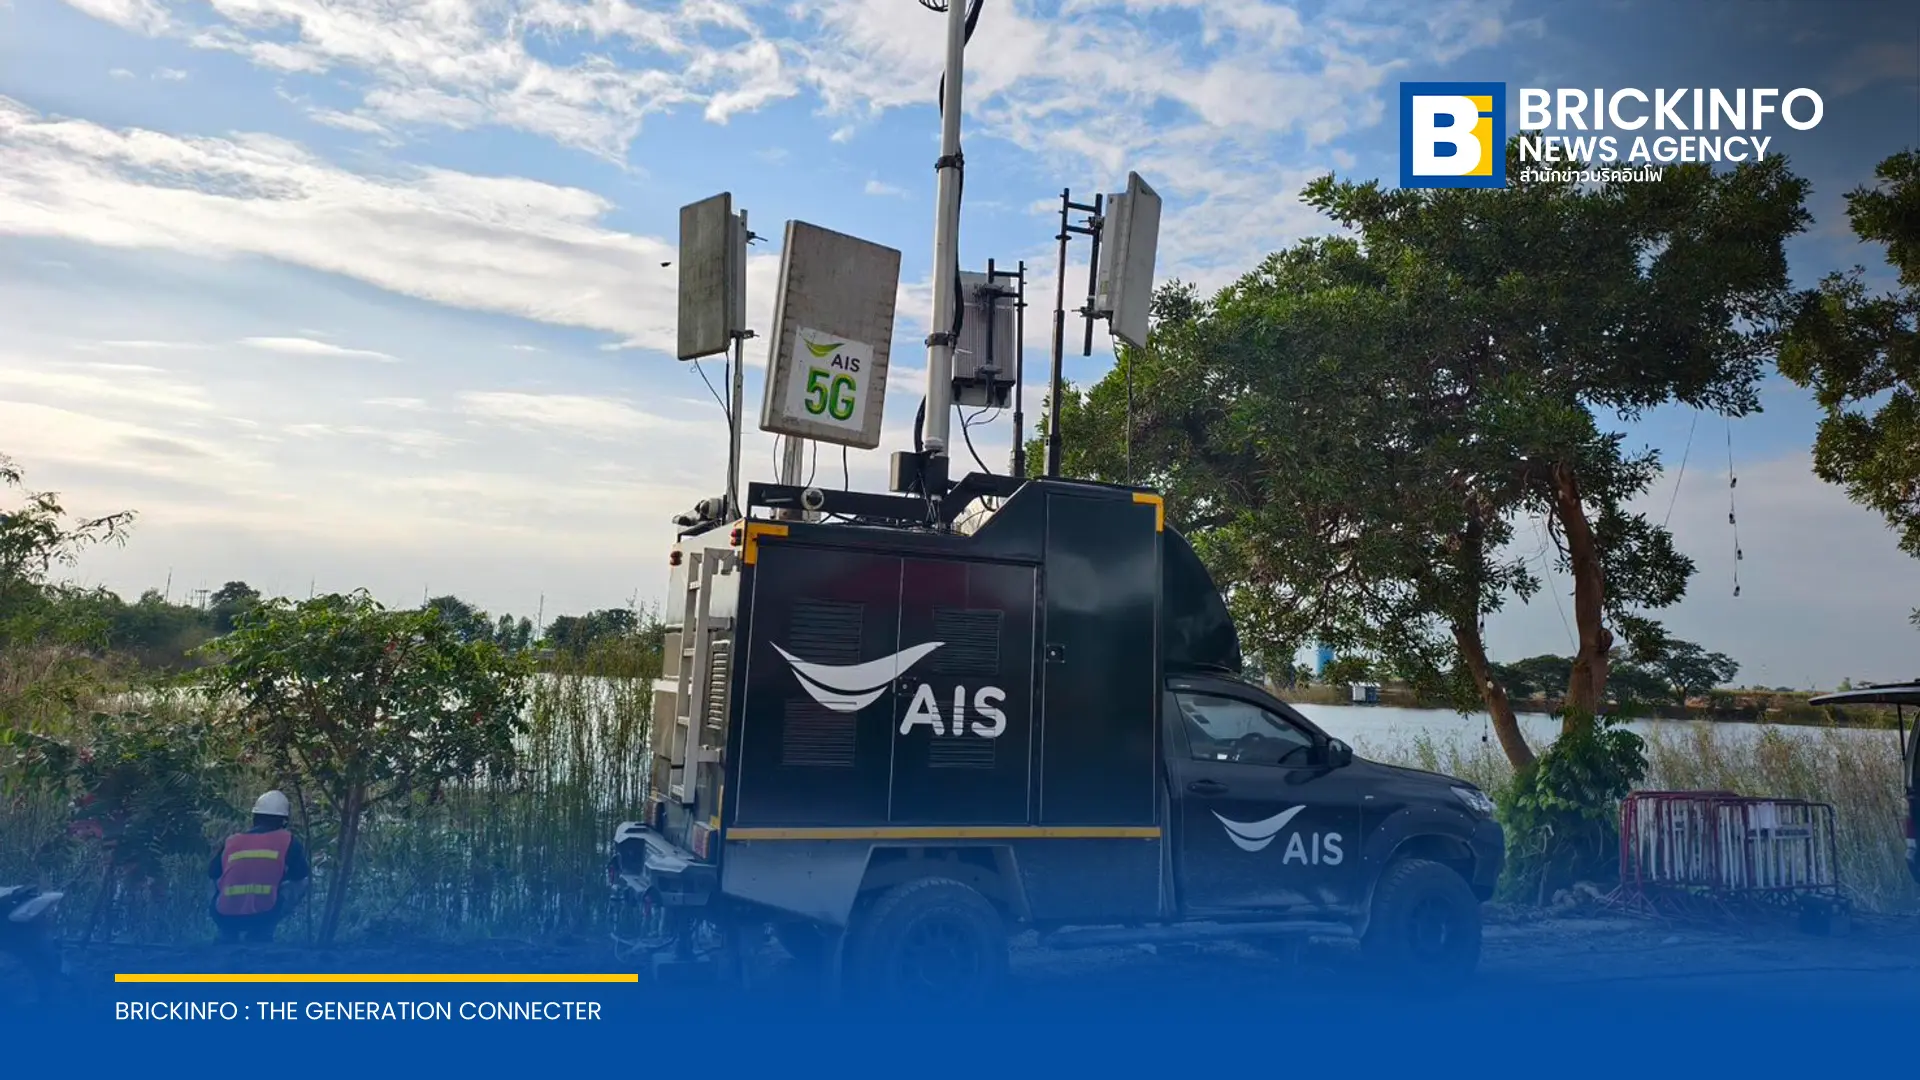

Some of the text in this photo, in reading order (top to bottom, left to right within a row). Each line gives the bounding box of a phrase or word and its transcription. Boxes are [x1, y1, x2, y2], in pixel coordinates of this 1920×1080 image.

[831, 353, 861, 373] AIS
[804, 366, 857, 421] 5G
[899, 683, 1007, 739] AIS
[1282, 832, 1344, 867] AIS
